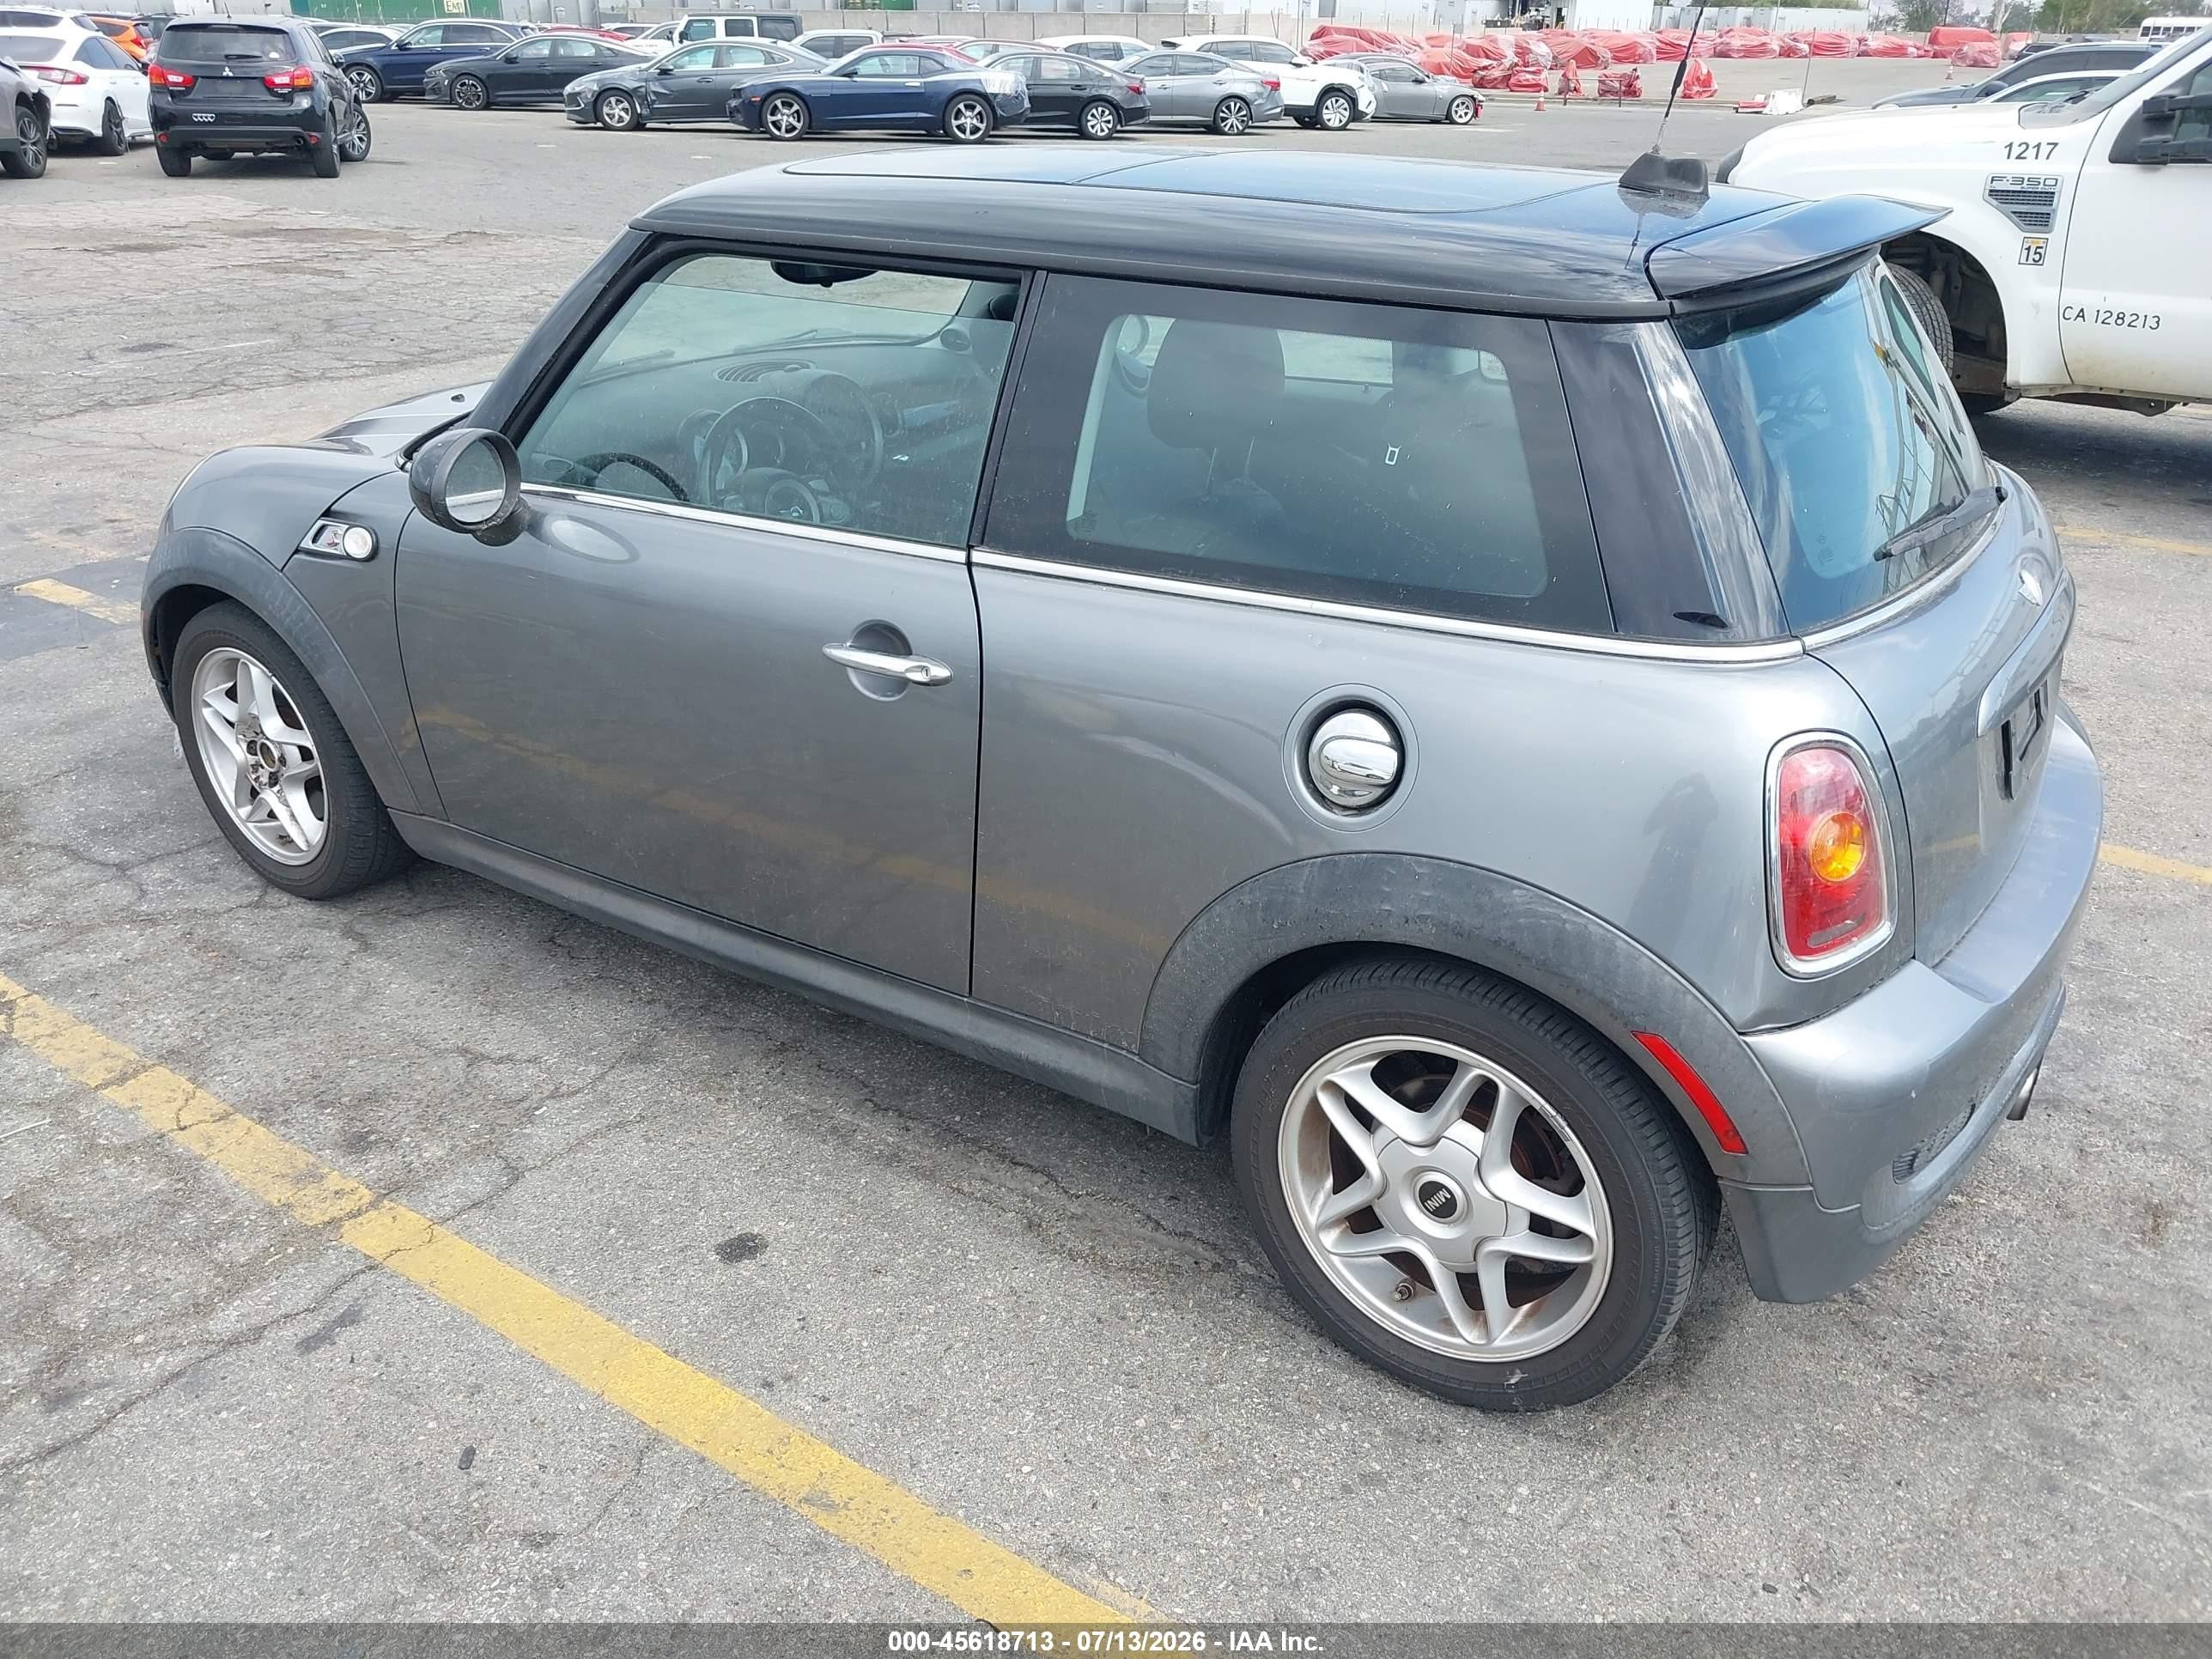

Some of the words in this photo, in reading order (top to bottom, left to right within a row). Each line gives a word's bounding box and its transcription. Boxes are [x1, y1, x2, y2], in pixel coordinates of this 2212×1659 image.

[2004, 142, 2059, 161] 1217
[2024, 245, 2044, 263] 15
[2062, 306, 2087, 323] CA
[2094, 309, 2161, 331] 128213
[1424, 1188, 1451, 1212] MINI
